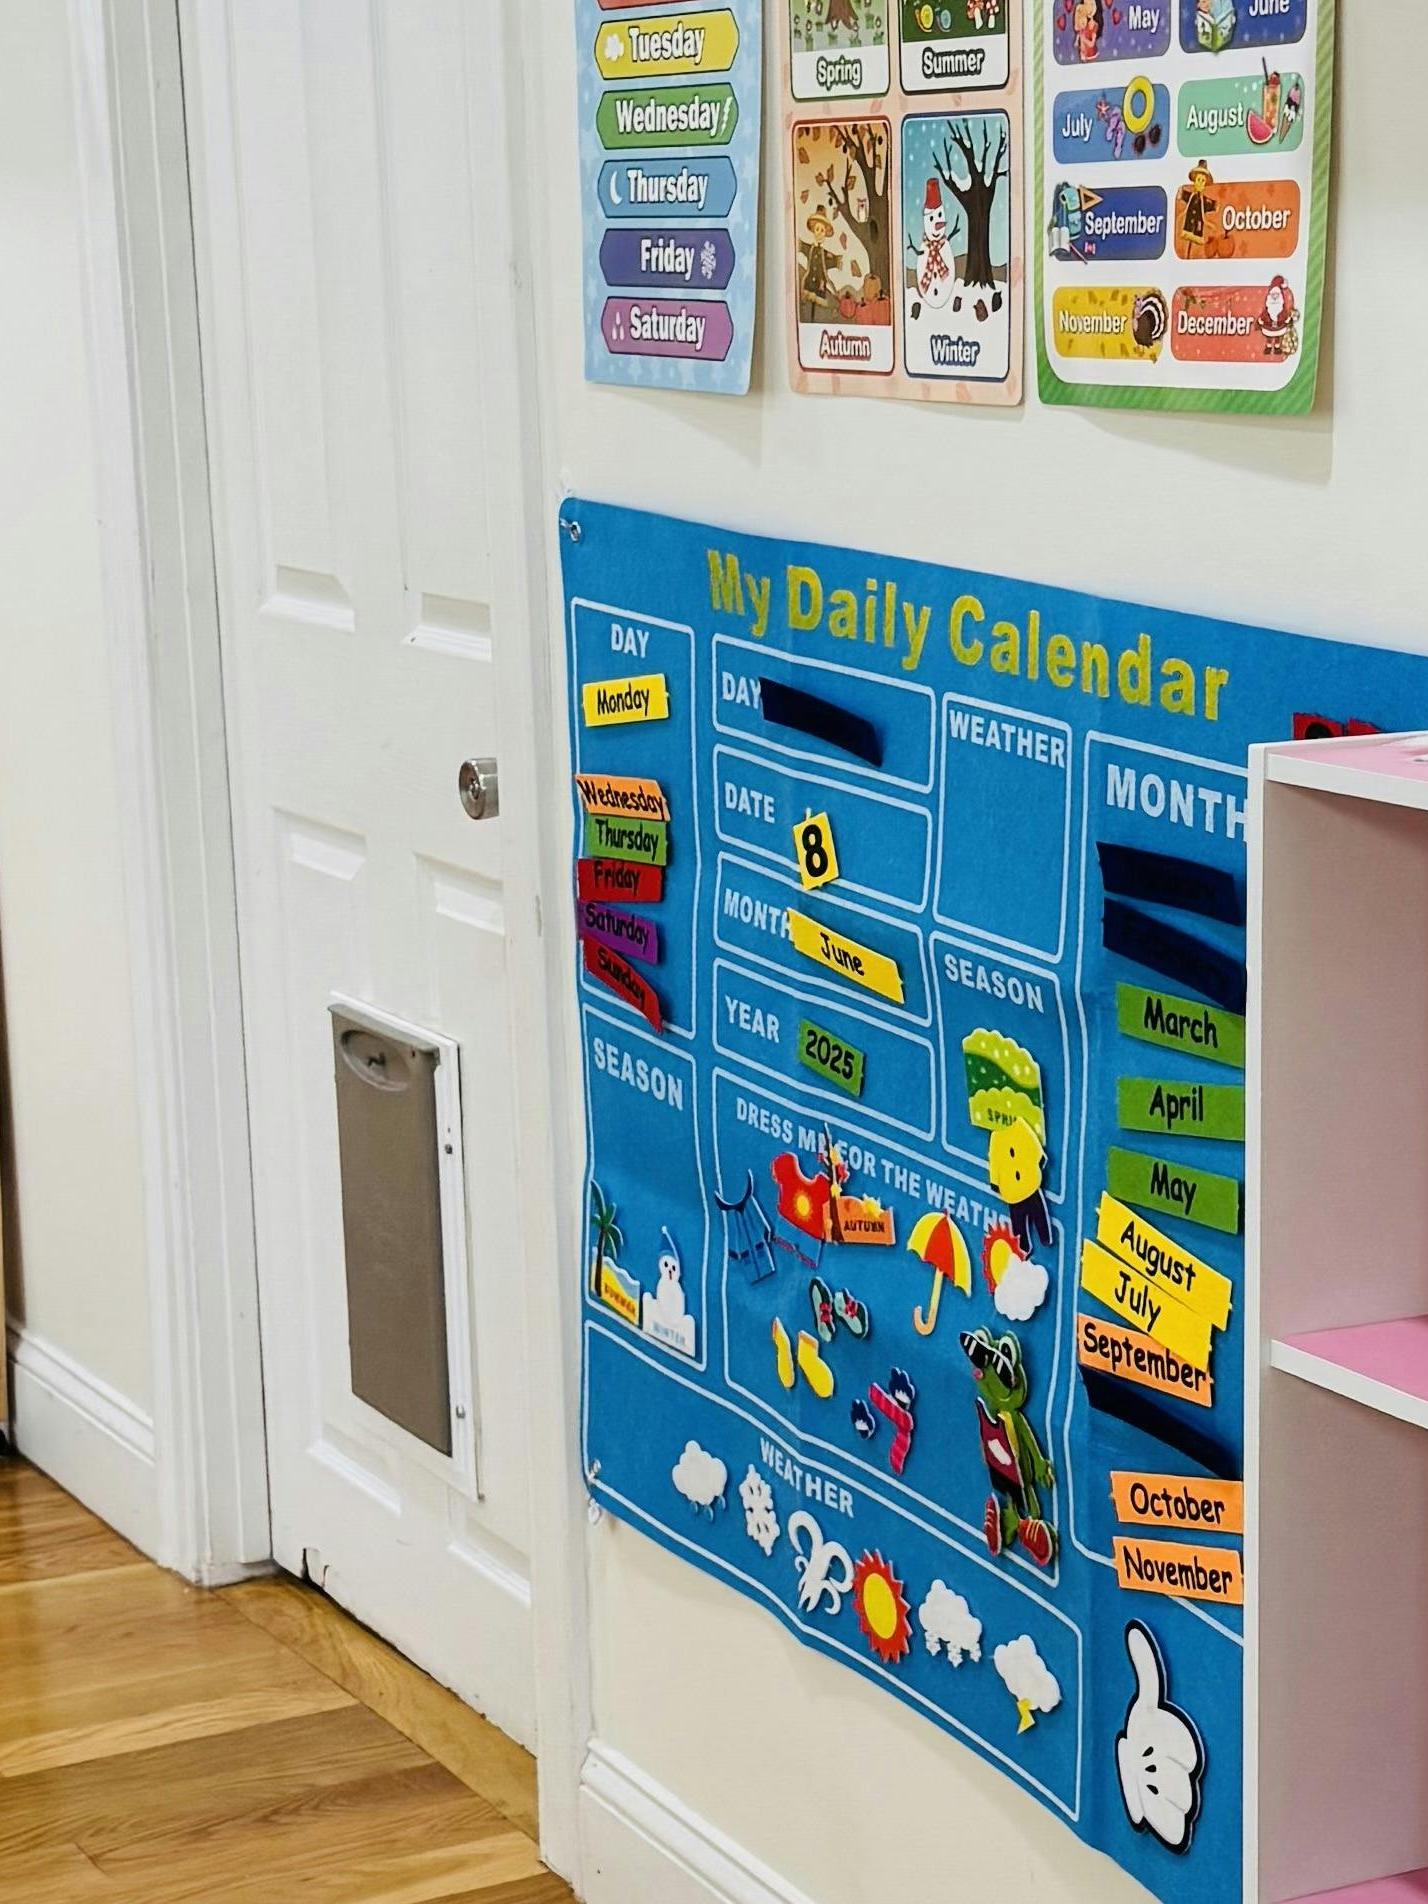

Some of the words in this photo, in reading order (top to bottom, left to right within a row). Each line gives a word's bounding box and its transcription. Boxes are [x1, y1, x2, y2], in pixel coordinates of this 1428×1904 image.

[1128, 5, 1160, 34] May
[628, 22, 705, 65] Tuesday
[922, 47, 985, 79] Summer
[816, 55, 863, 91] Spring
[615, 96, 721, 137] Wednesday
[1062, 113, 1093, 144] July
[1186, 102, 1244, 135] August
[626, 168, 708, 209] Thursday
[1085, 211, 1164, 240] September
[1222, 205, 1291, 232] October
[640, 239, 695, 281] Friday
[629, 306, 706, 351] Saturday
[1058, 309, 1128, 334] November
[1177, 309, 1255, 336] December
[820, 330, 871, 361] Autumn
[930, 334, 980, 366] Winter
[611, 622, 650, 659] DAY
[707, 549, 771, 638] My
[786, 563, 932, 671] Daily
[949, 595, 1230, 721] Calendar
[597, 681, 650, 716] Monday
[722, 672, 761, 710] DAY
[949, 709, 1066, 768] WEATHER
[577, 780, 666, 821] Wednesday
[725, 782, 775, 824] DATE
[1106, 763, 1248, 840] MONTH
[595, 818, 659, 862] Thursday
[802, 824, 829, 878] 8
[593, 861, 640, 897] Friday
[585, 902, 650, 954] Saturday
[820, 932, 865, 976] June
[598, 949, 645, 1010] Sunday
[944, 953, 1044, 1014] SEASON
[725, 995, 780, 1044] YEAR
[1143, 995, 1219, 1049] March
[594, 1037, 684, 1111] SEASON
[805, 1029, 855, 1081] 2025
[1149, 1085, 1204, 1130] April
[736, 1096, 793, 1145] DRESS
[880, 1158, 921, 1198] THE
[1150, 1161, 1197, 1216] May
[1120, 1220, 1197, 1292] August
[1114, 1270, 1161, 1333] July
[1083, 1322, 1207, 1392] September
[760, 1437, 854, 1519] WEATHER
[1130, 1482, 1226, 1524] October
[1123, 1545, 1233, 1595] November
